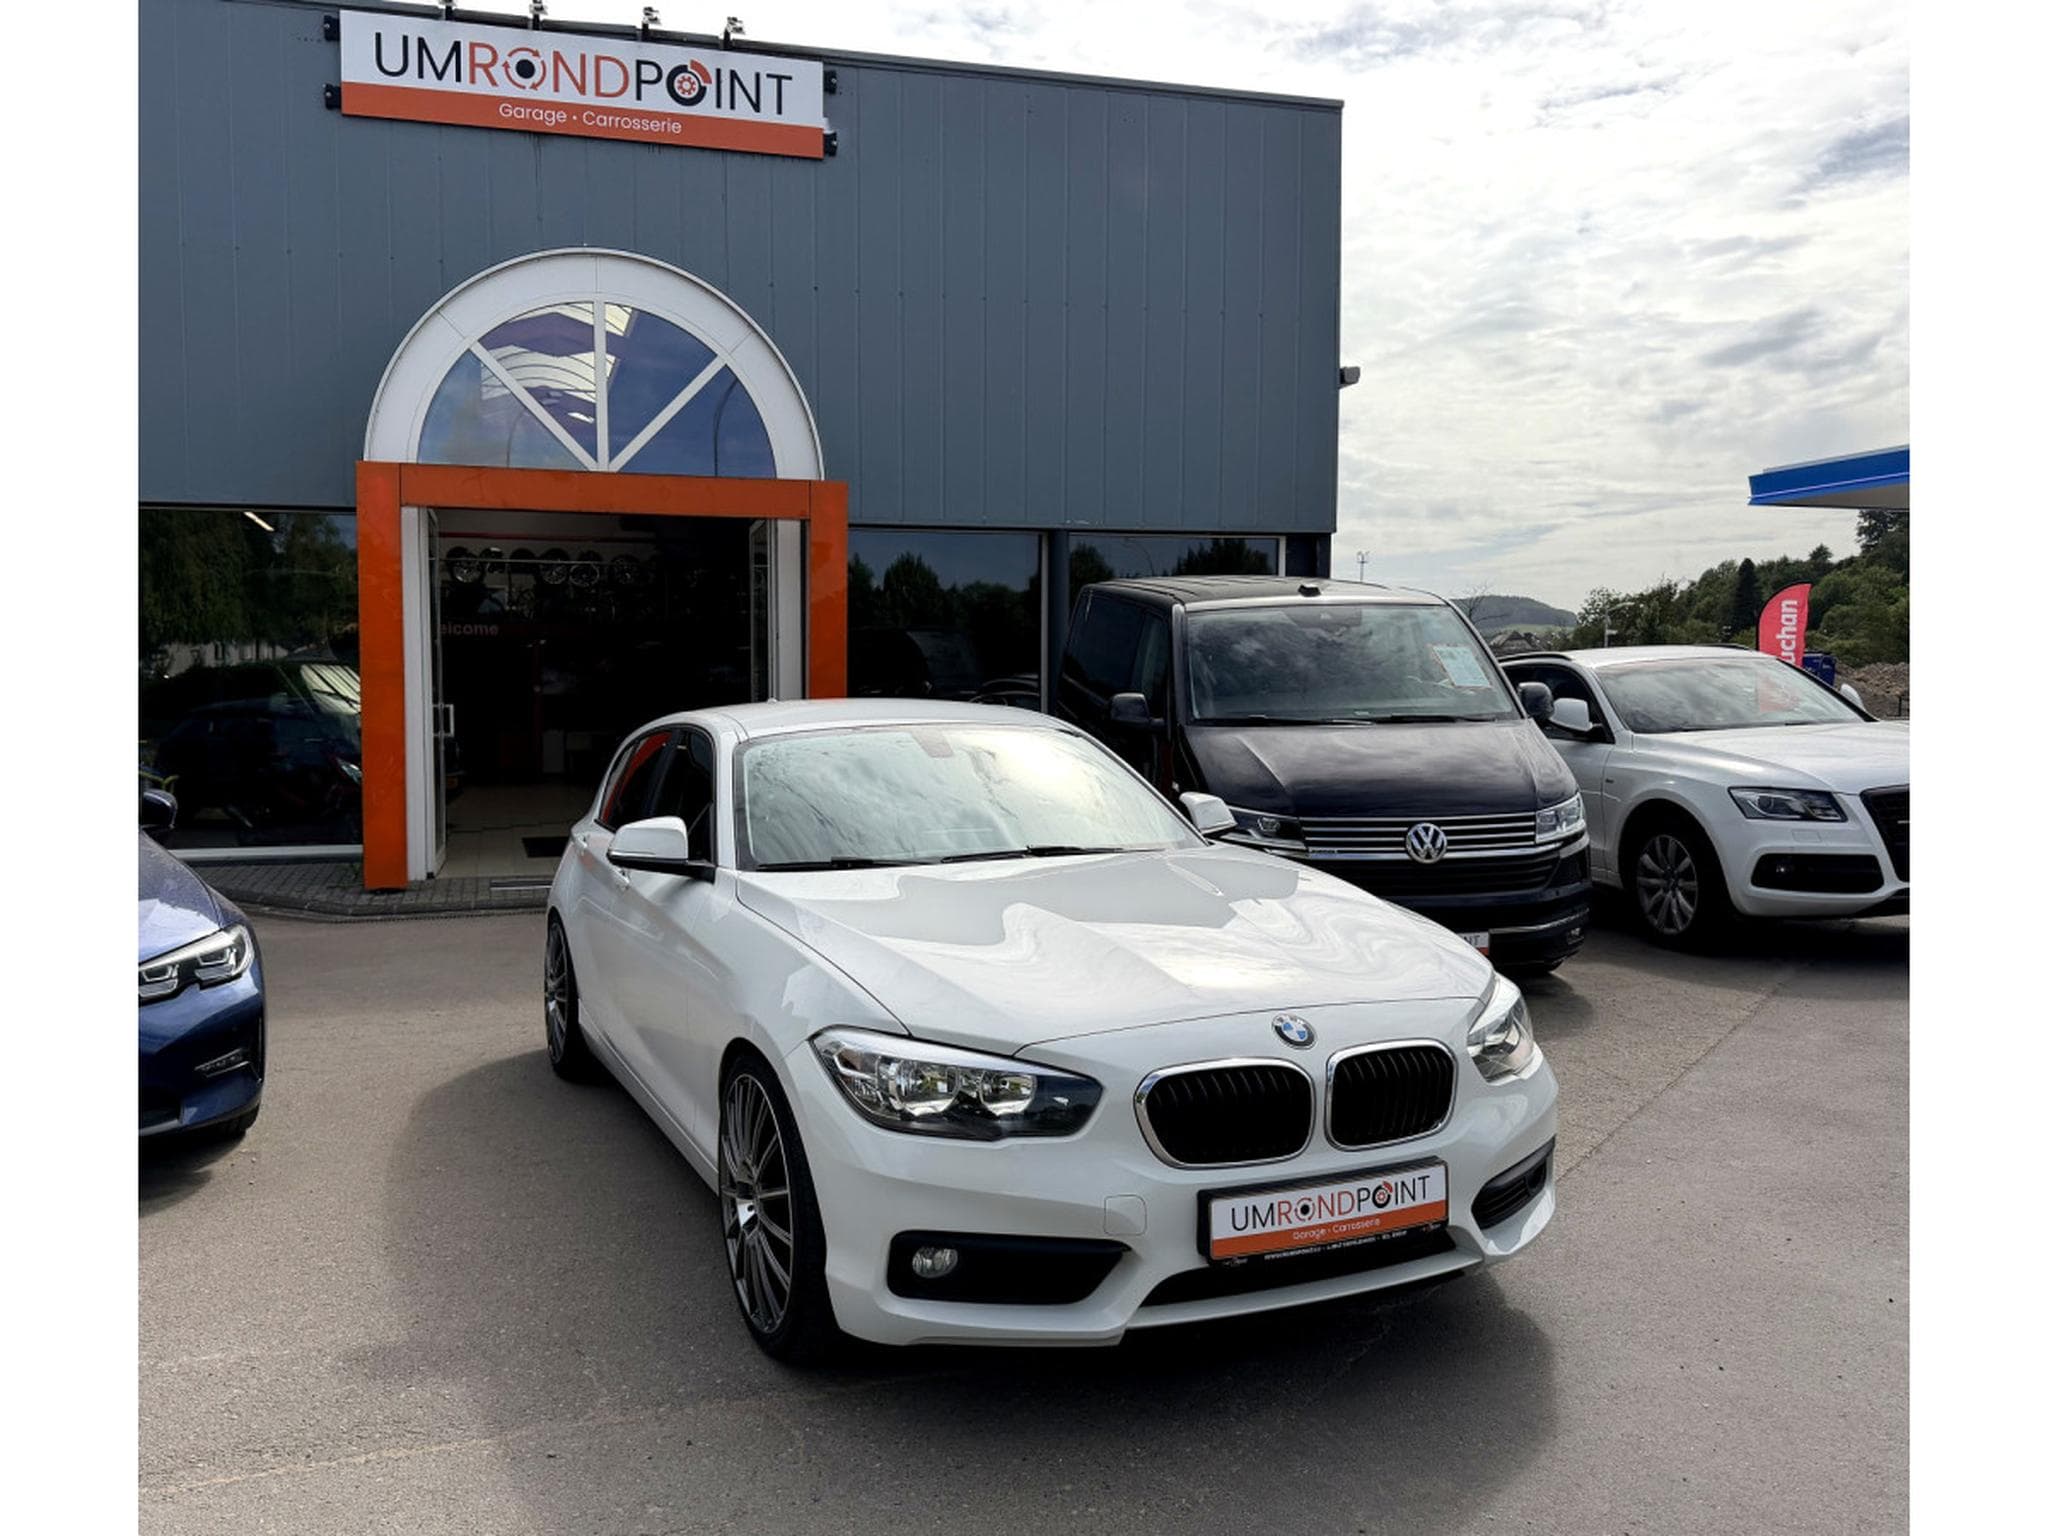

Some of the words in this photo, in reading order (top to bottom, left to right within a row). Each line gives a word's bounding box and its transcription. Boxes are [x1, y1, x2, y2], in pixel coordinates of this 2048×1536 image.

[374, 31, 793, 115] UMRONDPOINT
[499, 102, 567, 127] Garage
[582, 110, 682, 135] Carrosserie
[439, 621, 499, 637] elcome
[1776, 599, 1798, 664] uchan
[1292, 1228, 1327, 1240] Garage
